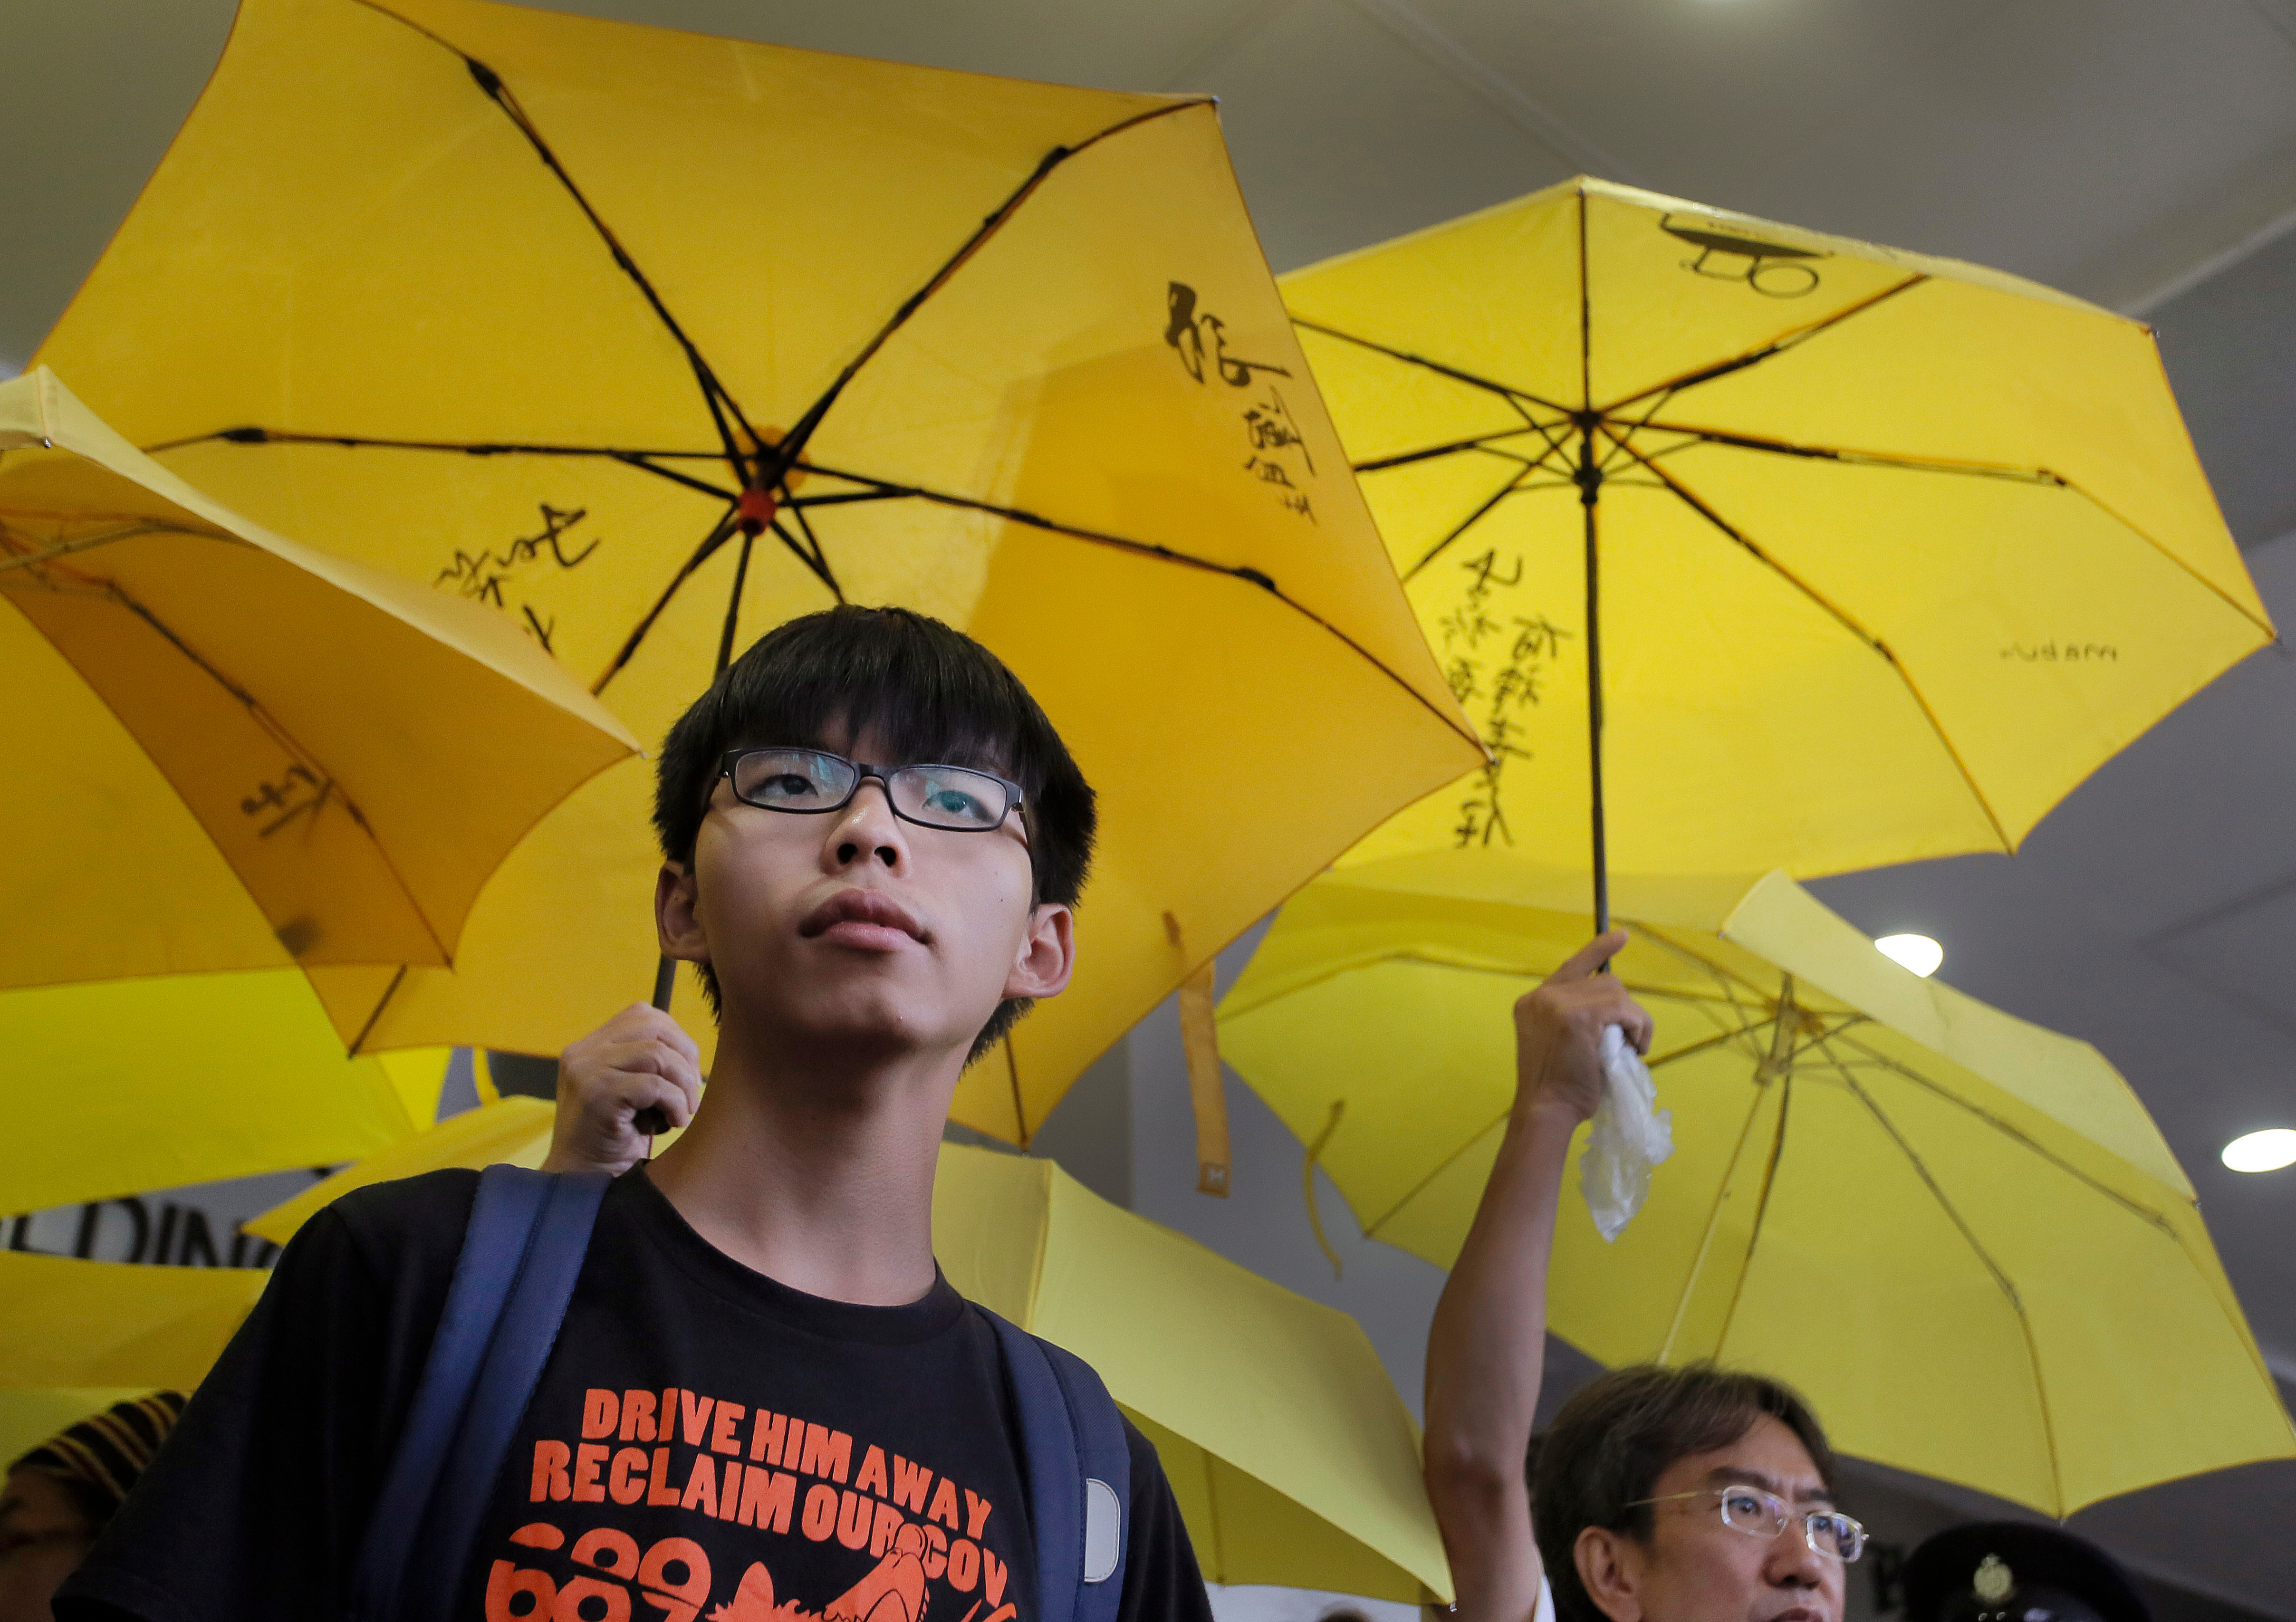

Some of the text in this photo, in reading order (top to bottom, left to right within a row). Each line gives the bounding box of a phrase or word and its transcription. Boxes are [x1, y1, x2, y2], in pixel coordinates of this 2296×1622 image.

[529, 1440, 797, 1535] RECLAIM
[801, 1483, 904, 1558] OUR
[581, 1388, 992, 1540] DRIVE HIM AWAY
